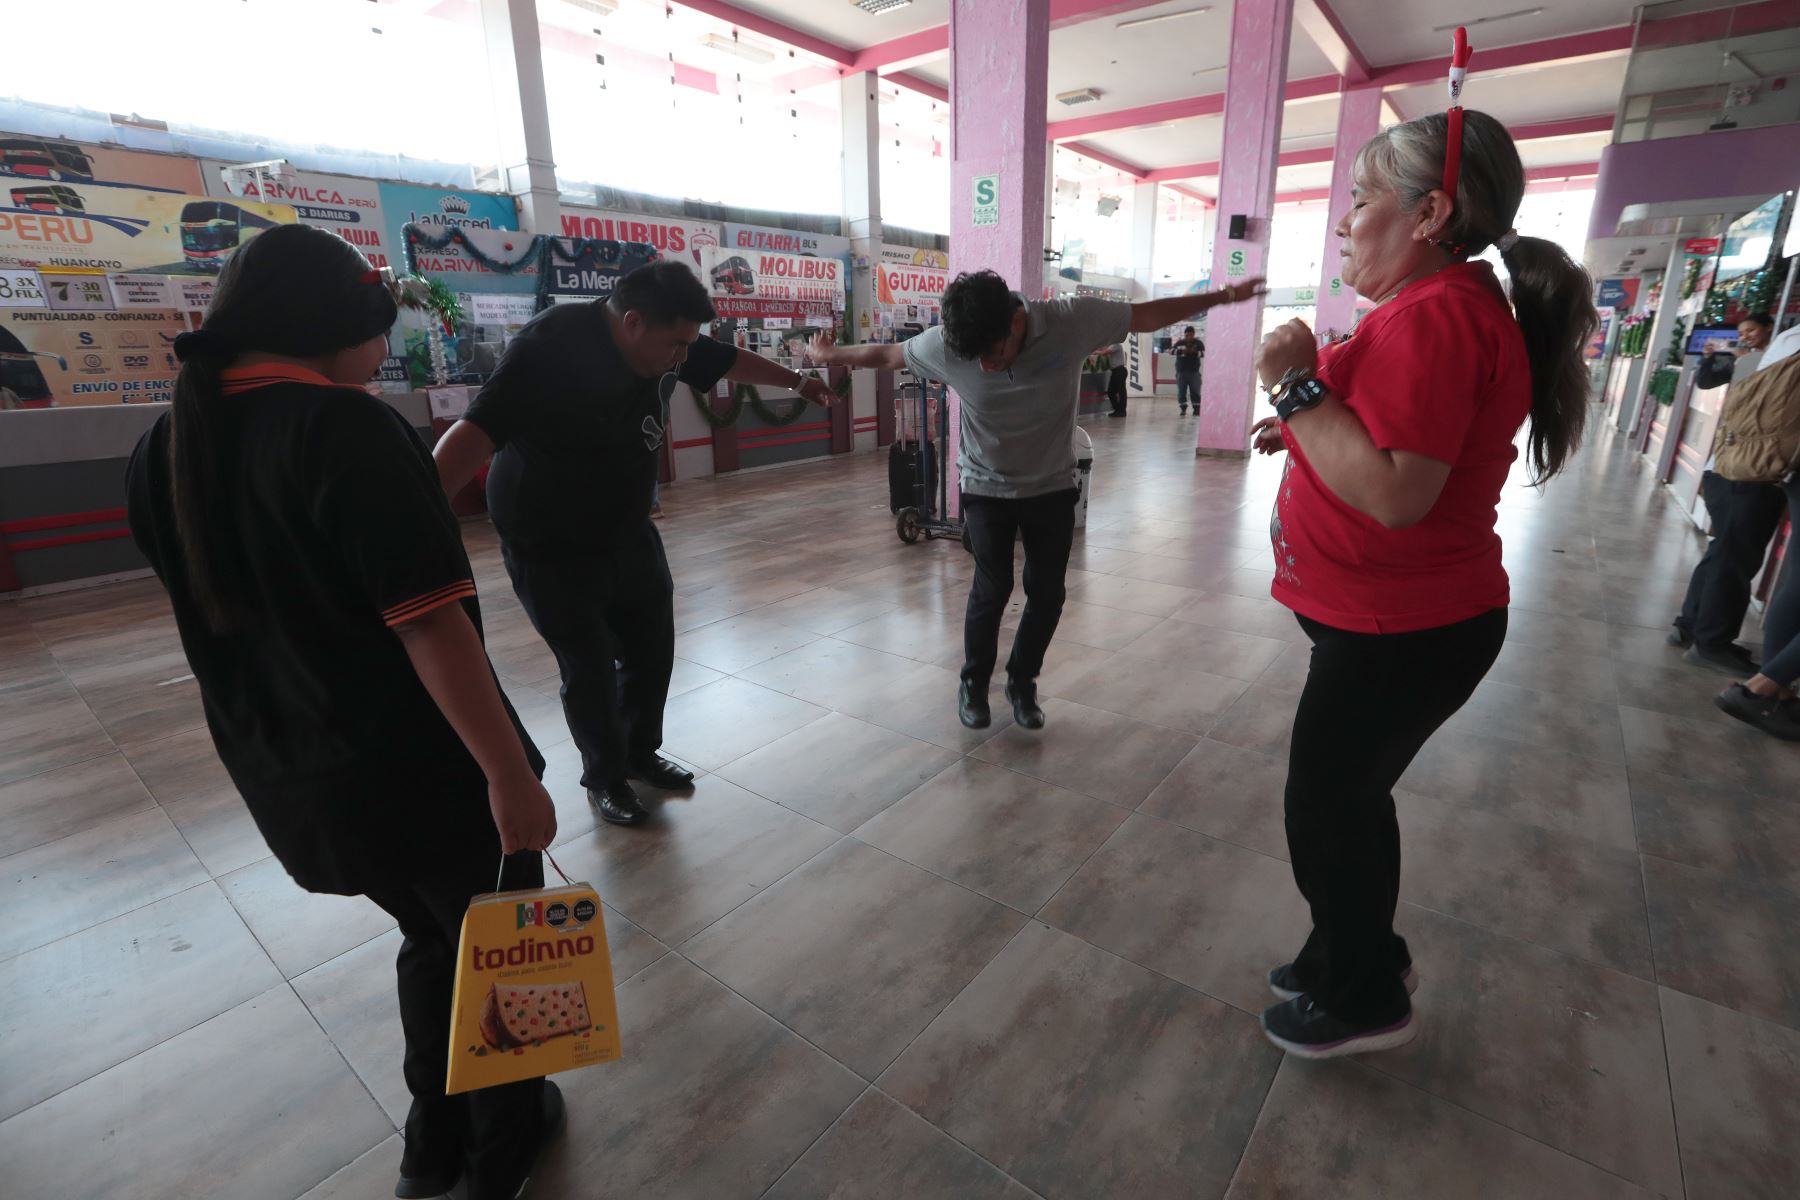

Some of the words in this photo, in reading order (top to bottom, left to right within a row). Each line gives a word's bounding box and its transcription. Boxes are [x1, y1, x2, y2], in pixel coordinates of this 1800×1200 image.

[224, 181, 344, 205] ARIVILCA
[976, 180, 994, 205] S
[310, 209, 351, 220] DIARIAS
[338, 228, 380, 246] AUJA
[802, 239, 818, 249] BUS
[413, 247, 460, 256] EXPRESO
[48, 257, 122, 268] HUANCAYO
[1231, 251, 1244, 265] S
[416, 257, 511, 273] WARIVIL
[760, 256, 836, 280] MOLIBUS
[16, 277, 36, 287] 3X
[556, 269, 580, 288] La
[582, 270, 622, 290] Merc
[888, 272, 949, 293] GUTARR
[1331, 278, 1340, 289] S
[16, 290, 44, 298] FILA
[50, 282, 69, 301] 7
[758, 284, 790, 299] SATIPO
[85, 294, 104, 302] PM
[12, 312, 95, 321] PUNTUALIDAD
[104, 313, 164, 321] CONFIANZA
[382, 358, 402, 368] NDA
[377, 370, 404, 379] ETES
[73, 380, 118, 393] ENVÍO
[123, 382, 140, 391] DE
[144, 380, 176, 390] ENCO
[144, 392, 170, 402] GEN
[472, 935, 595, 971] todinno
